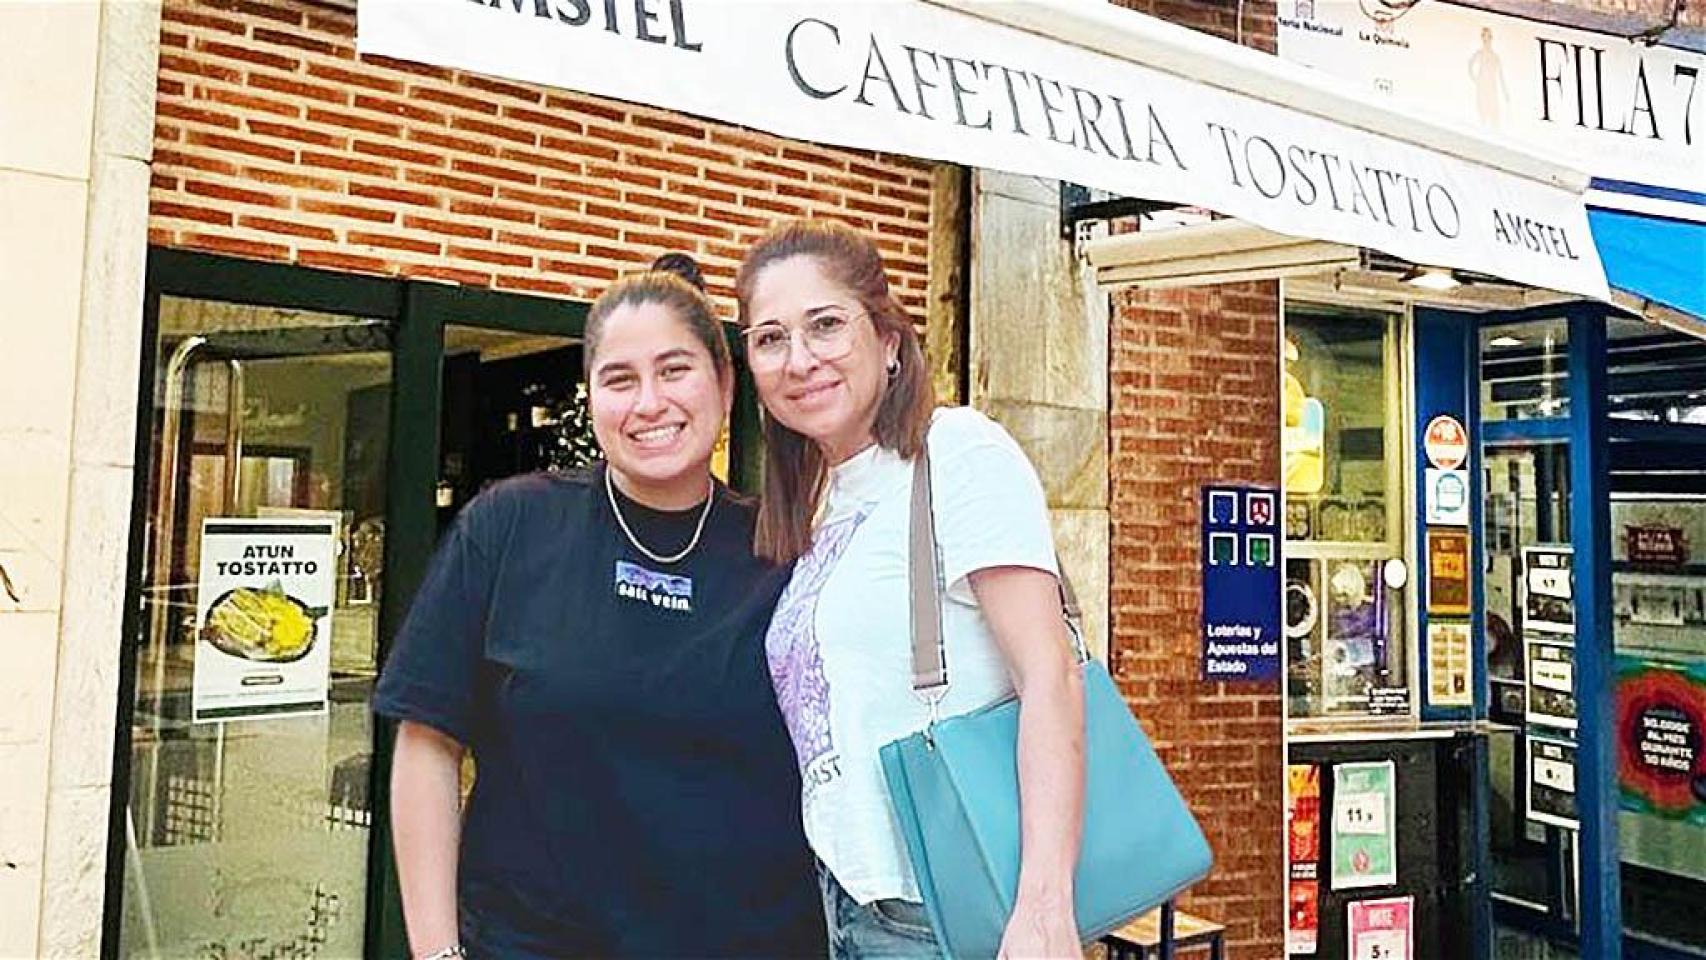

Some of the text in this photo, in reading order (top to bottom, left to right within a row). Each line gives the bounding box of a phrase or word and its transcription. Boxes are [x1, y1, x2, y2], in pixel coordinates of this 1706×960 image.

[467, 0, 702, 51] TEL
[1535, 37, 1699, 145] FILA 7
[785, 18, 1579, 260] CAFETERIA TOSTATTO AMSTEL
[243, 545, 293, 558] ATUN
[217, 561, 317, 575] TOSTATTO
[1207, 641, 1258, 657] Apuestas
[1207, 659, 1247, 674] Estado
